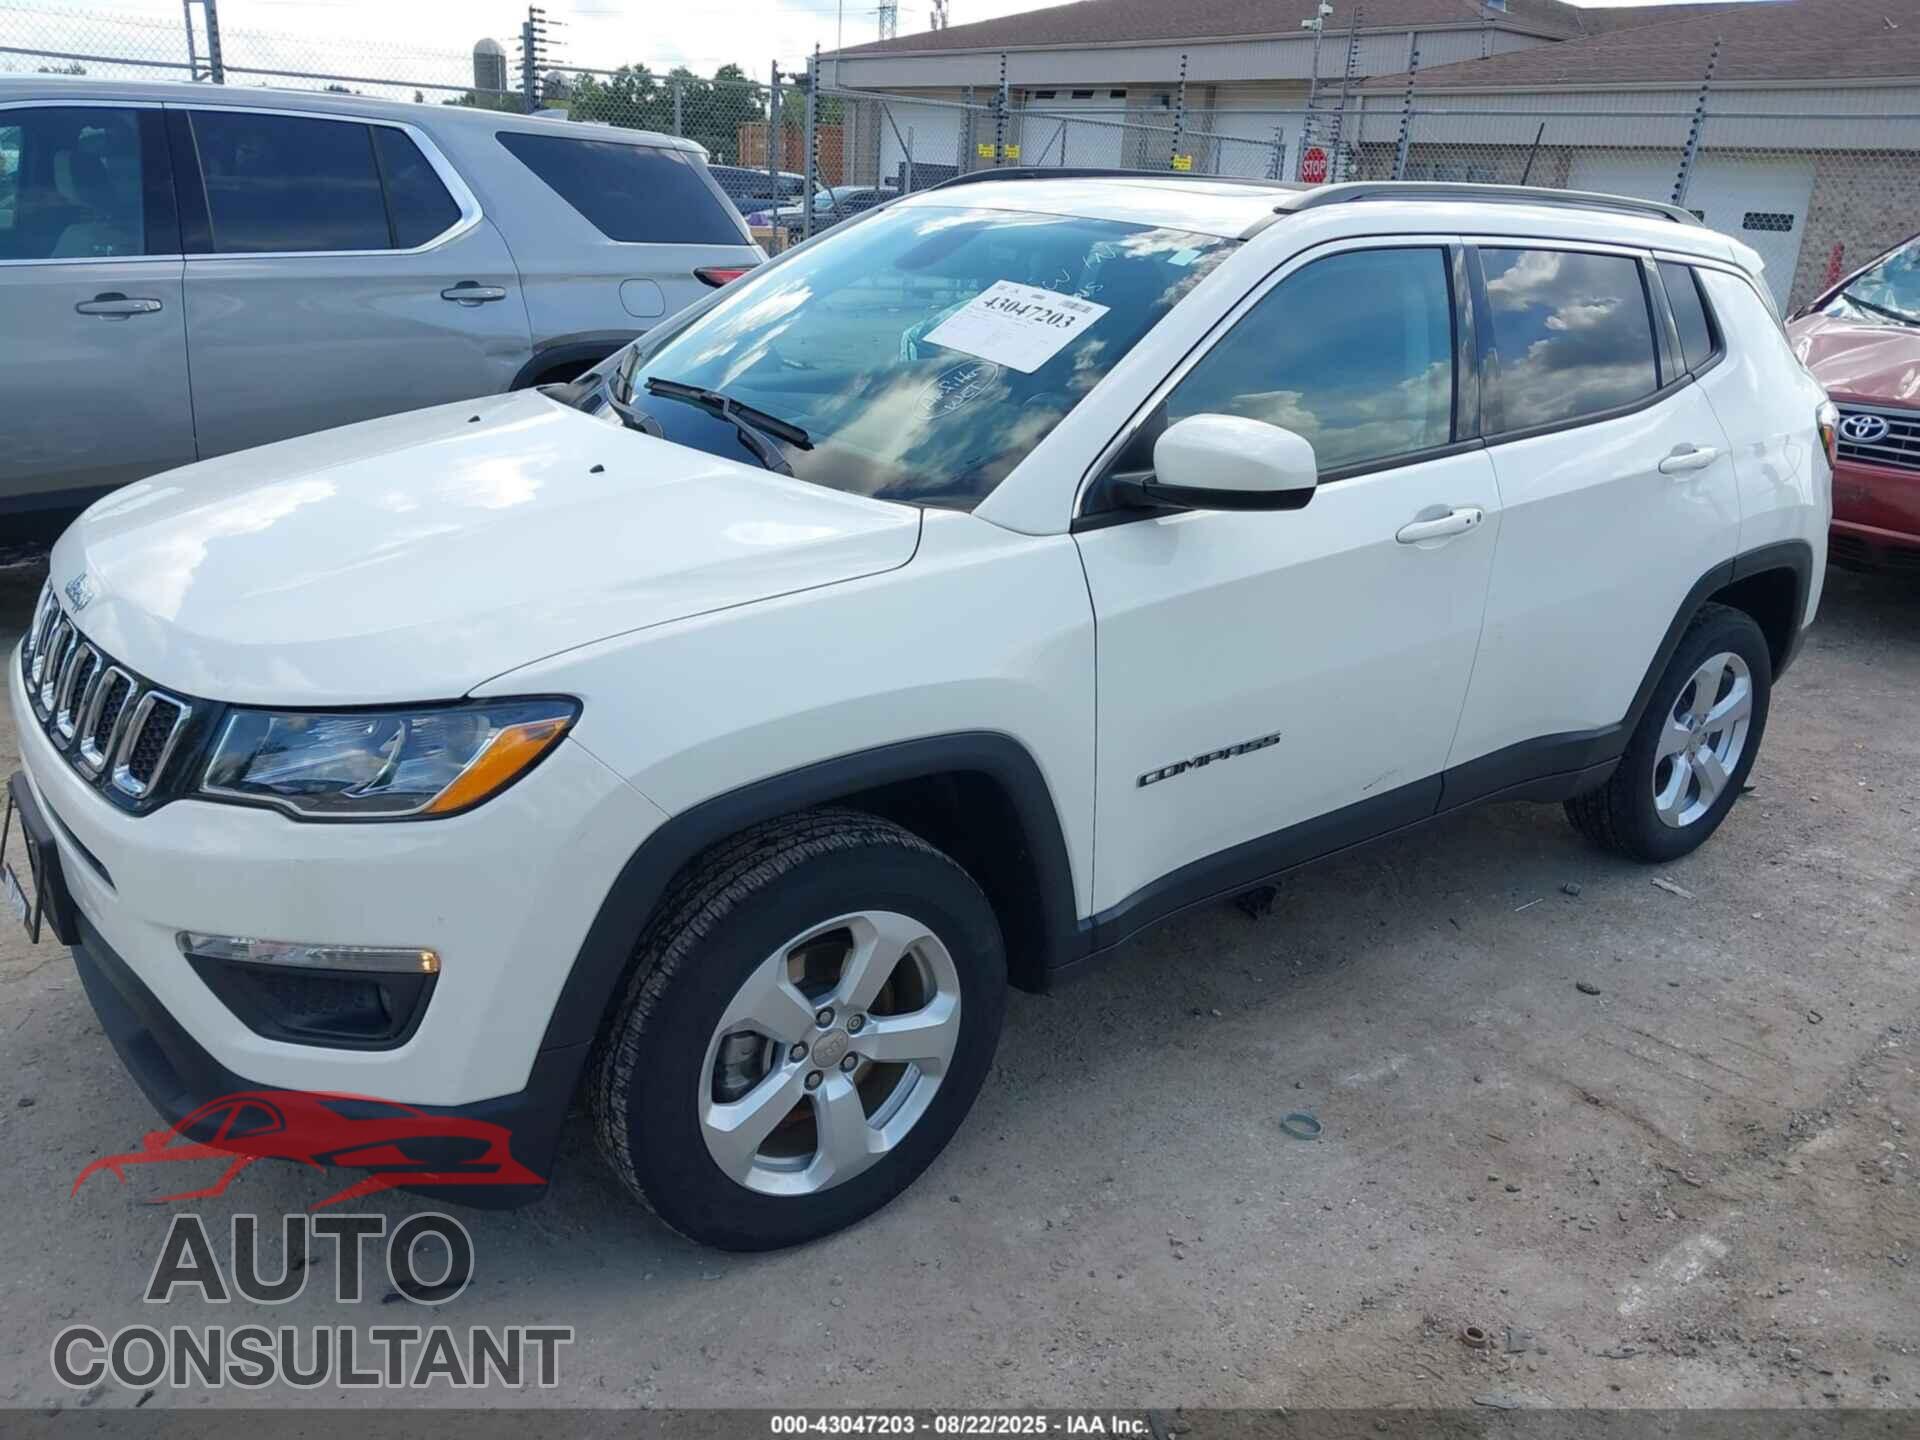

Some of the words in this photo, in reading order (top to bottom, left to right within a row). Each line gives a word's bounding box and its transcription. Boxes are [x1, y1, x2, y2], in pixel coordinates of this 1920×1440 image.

[1303, 160, 1327, 177] STOP
[984, 295, 1077, 330] 43047203
[1137, 731, 1281, 788] COMPASS
